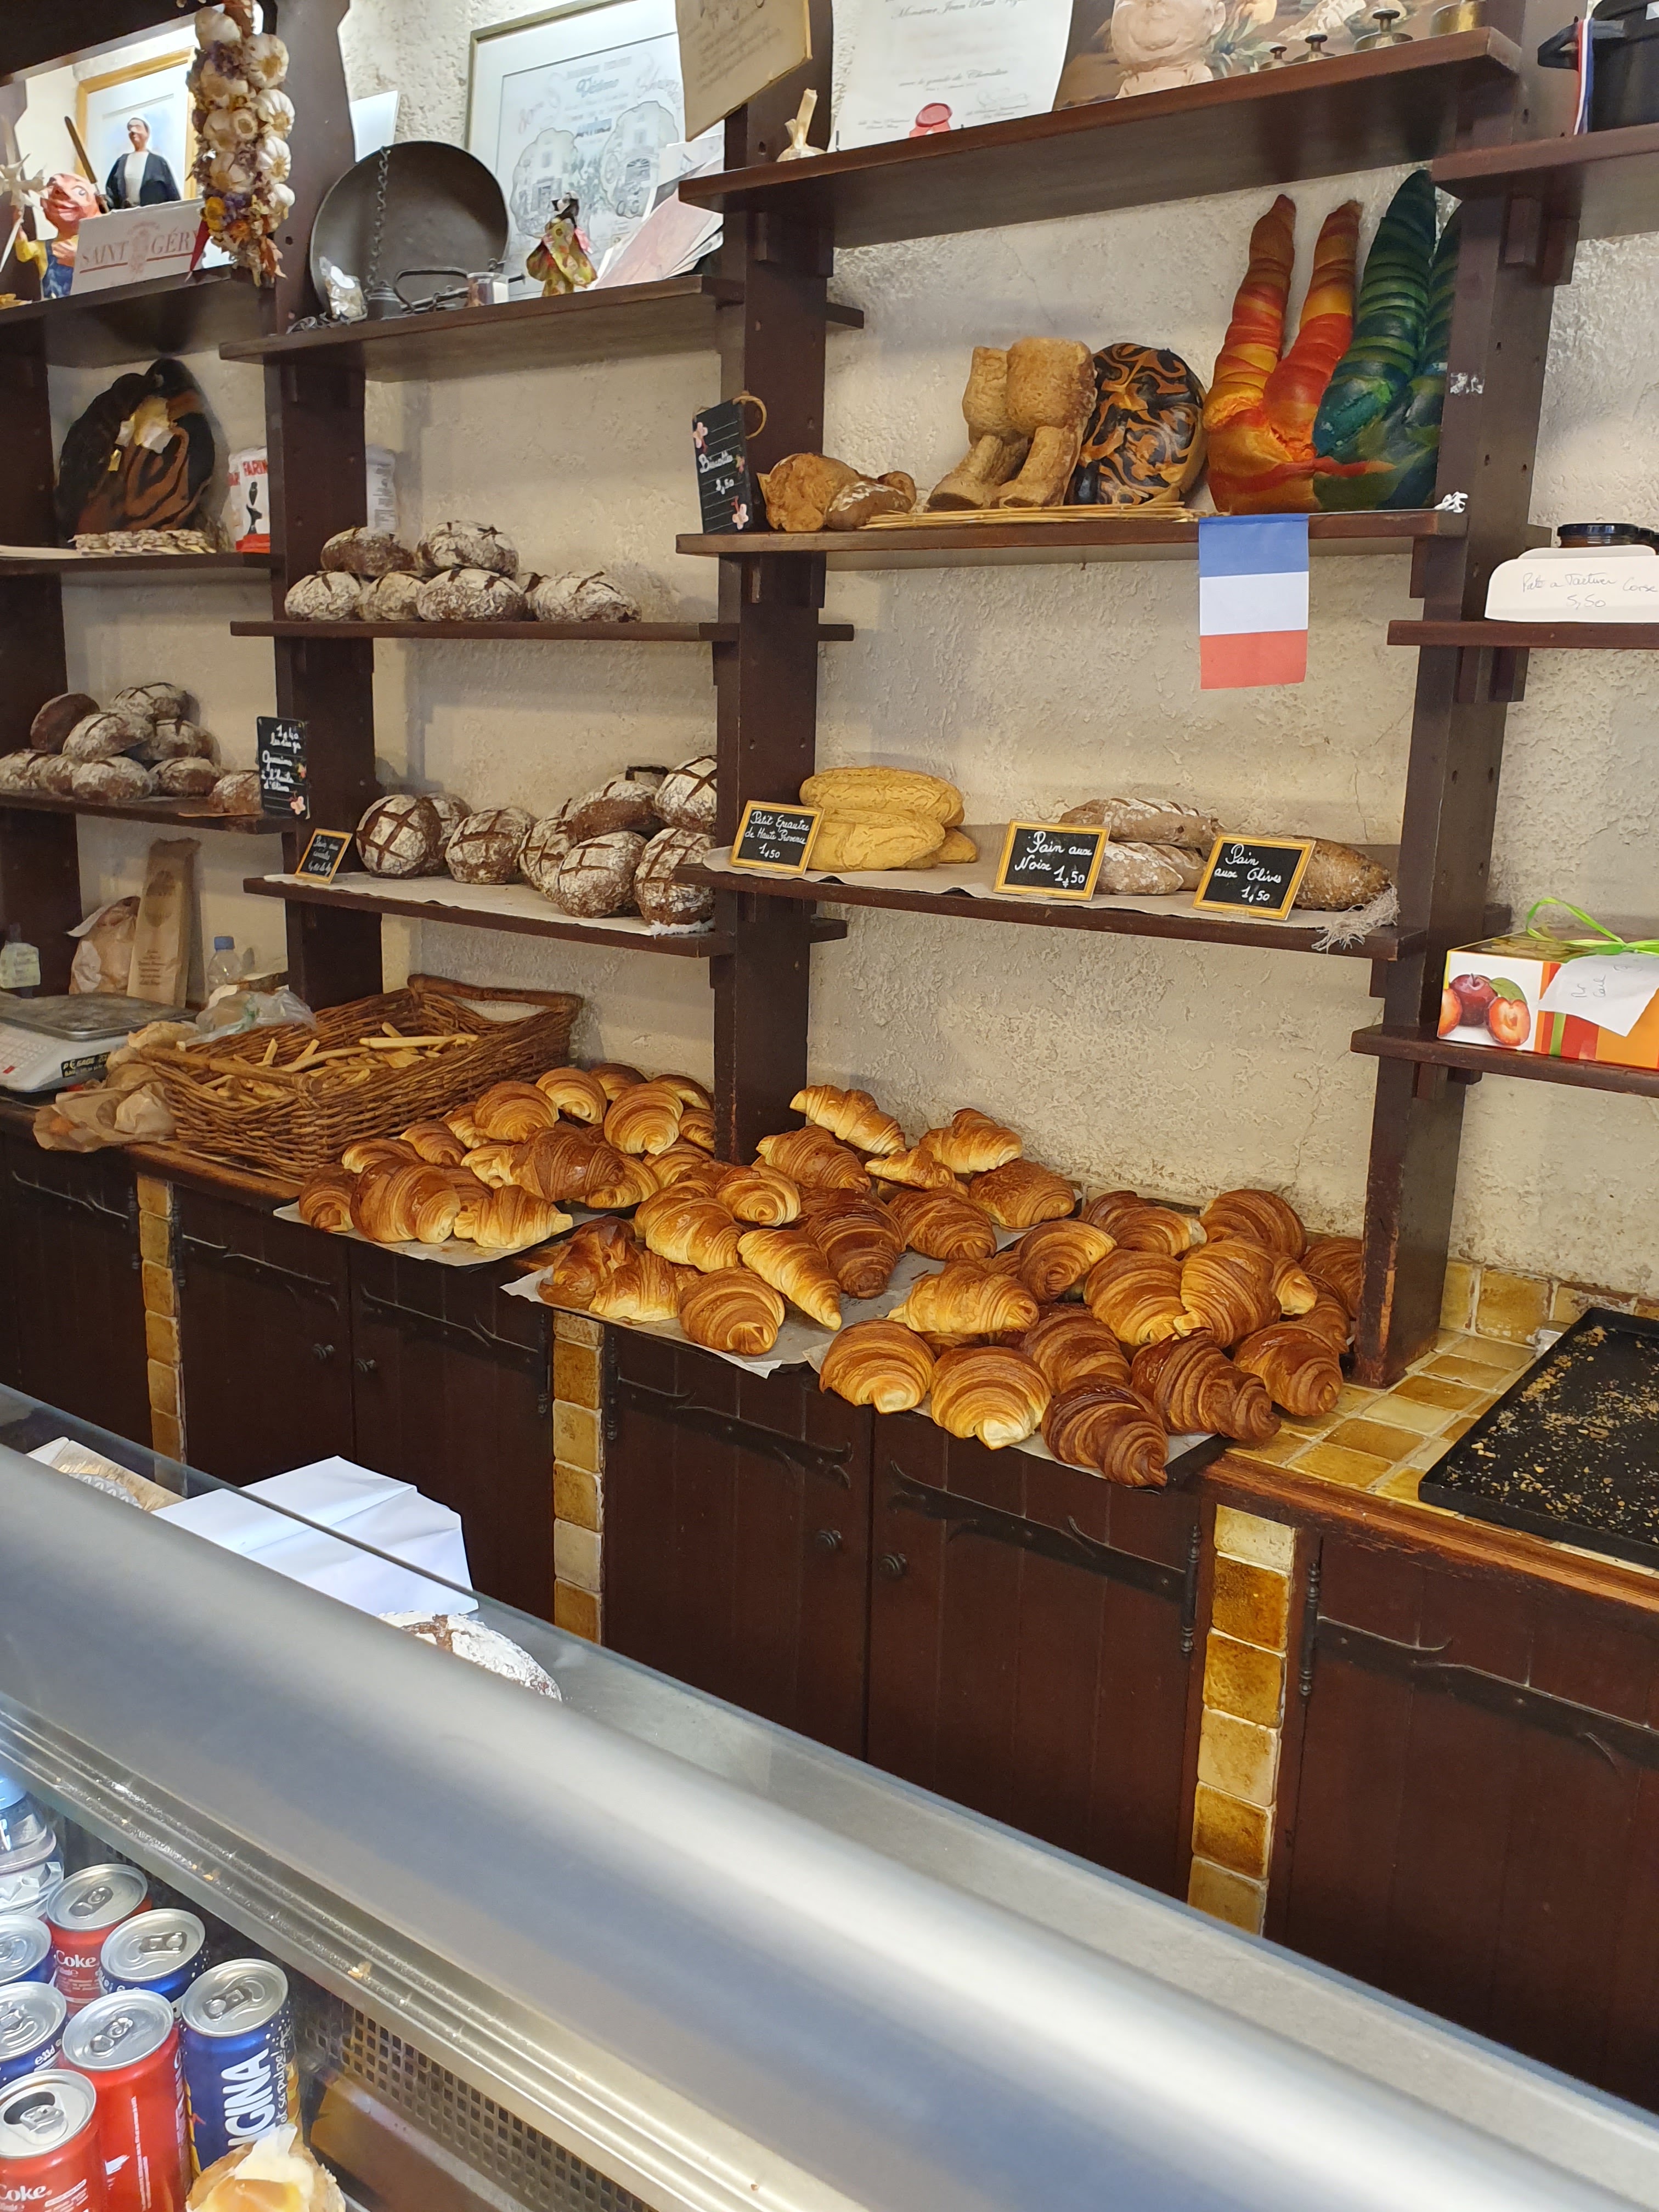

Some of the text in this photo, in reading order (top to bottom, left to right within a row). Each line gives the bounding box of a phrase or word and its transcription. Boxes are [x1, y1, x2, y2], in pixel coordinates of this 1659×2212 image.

[80, 240, 129, 266] SAINT
[750, 811, 810, 832] Petit Epeautre
[744, 826, 807, 845] de Haute Provence
[1026, 831, 1093, 855] Pain aux
[758, 843, 781, 858] 1,50
[1225, 843, 1259, 866] Pain
[1014, 855, 1085, 888] Noix 1,50
[1214, 867, 1282, 883] aux Olives
[1241, 885, 1271, 902] 1,50
[278, 2093, 287, 2108] sa
